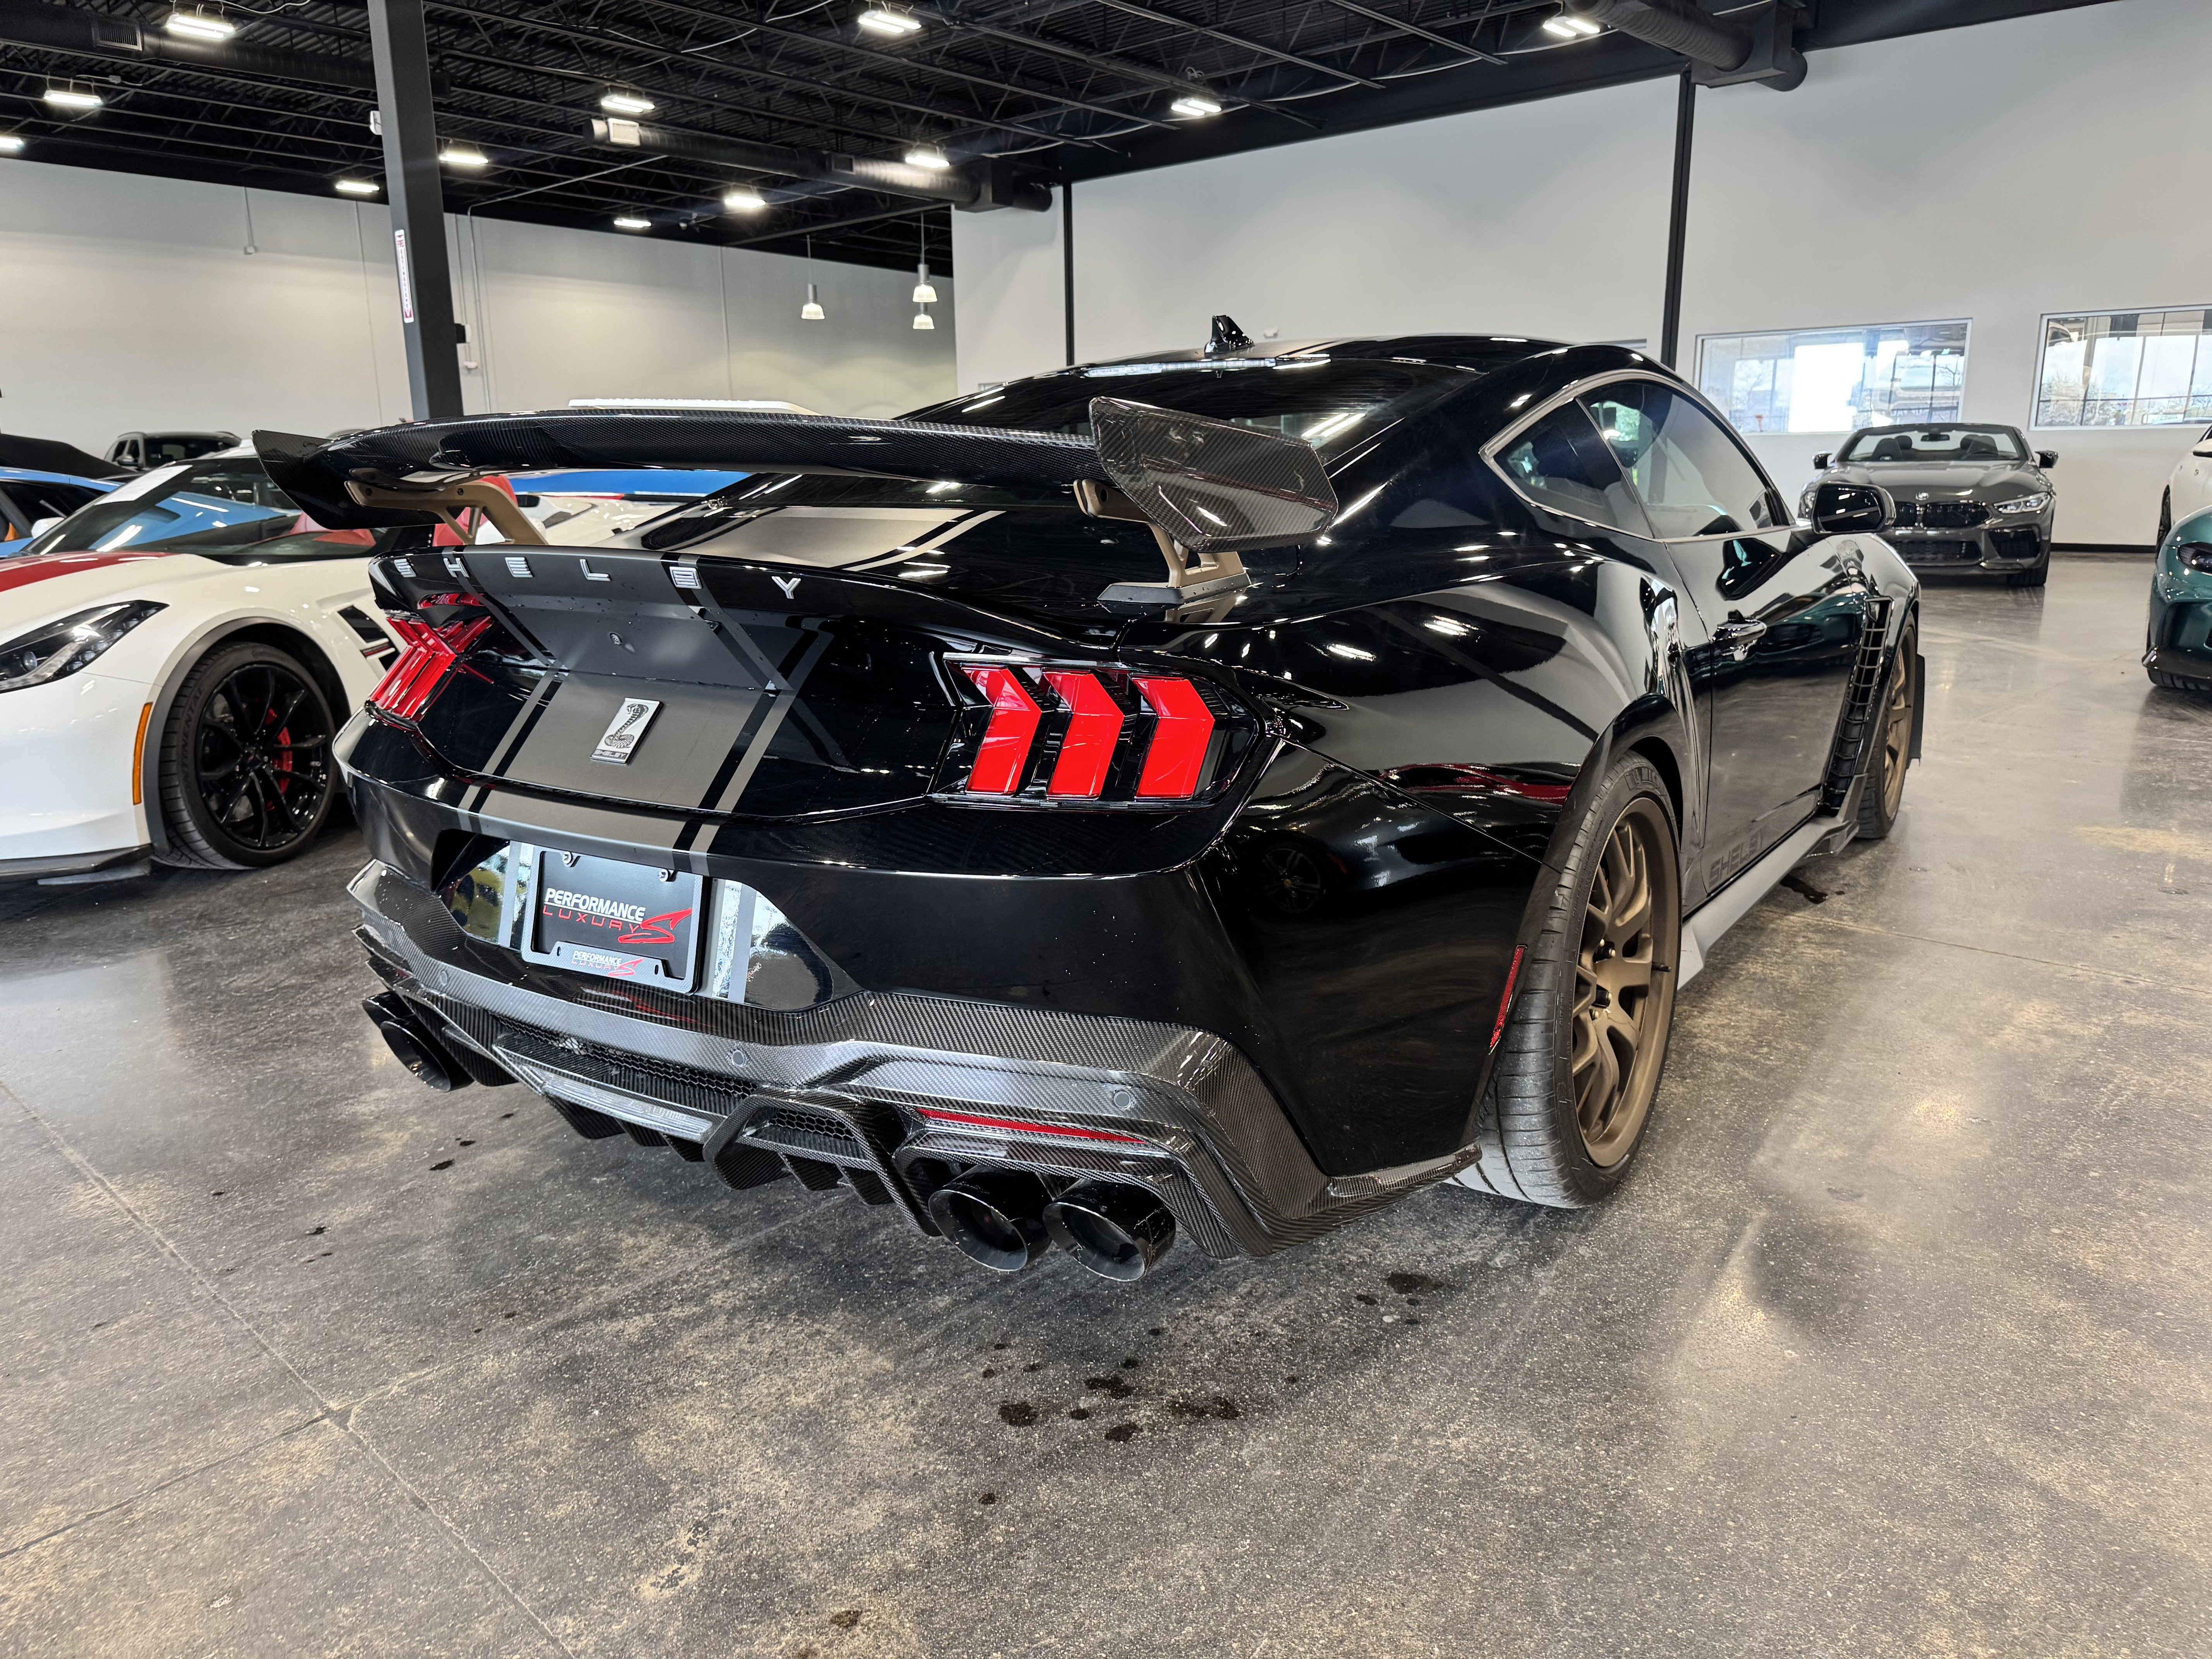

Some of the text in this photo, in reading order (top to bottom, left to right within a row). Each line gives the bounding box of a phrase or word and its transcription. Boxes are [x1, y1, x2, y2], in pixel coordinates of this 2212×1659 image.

[394, 555, 801, 600] SHELBY
[594, 749, 626, 758] SHELBY
[545, 888, 646, 921] PERFORMANCE
[543, 905, 640, 933] LUXURY
[574, 950, 622, 965] PERFORMANCE
